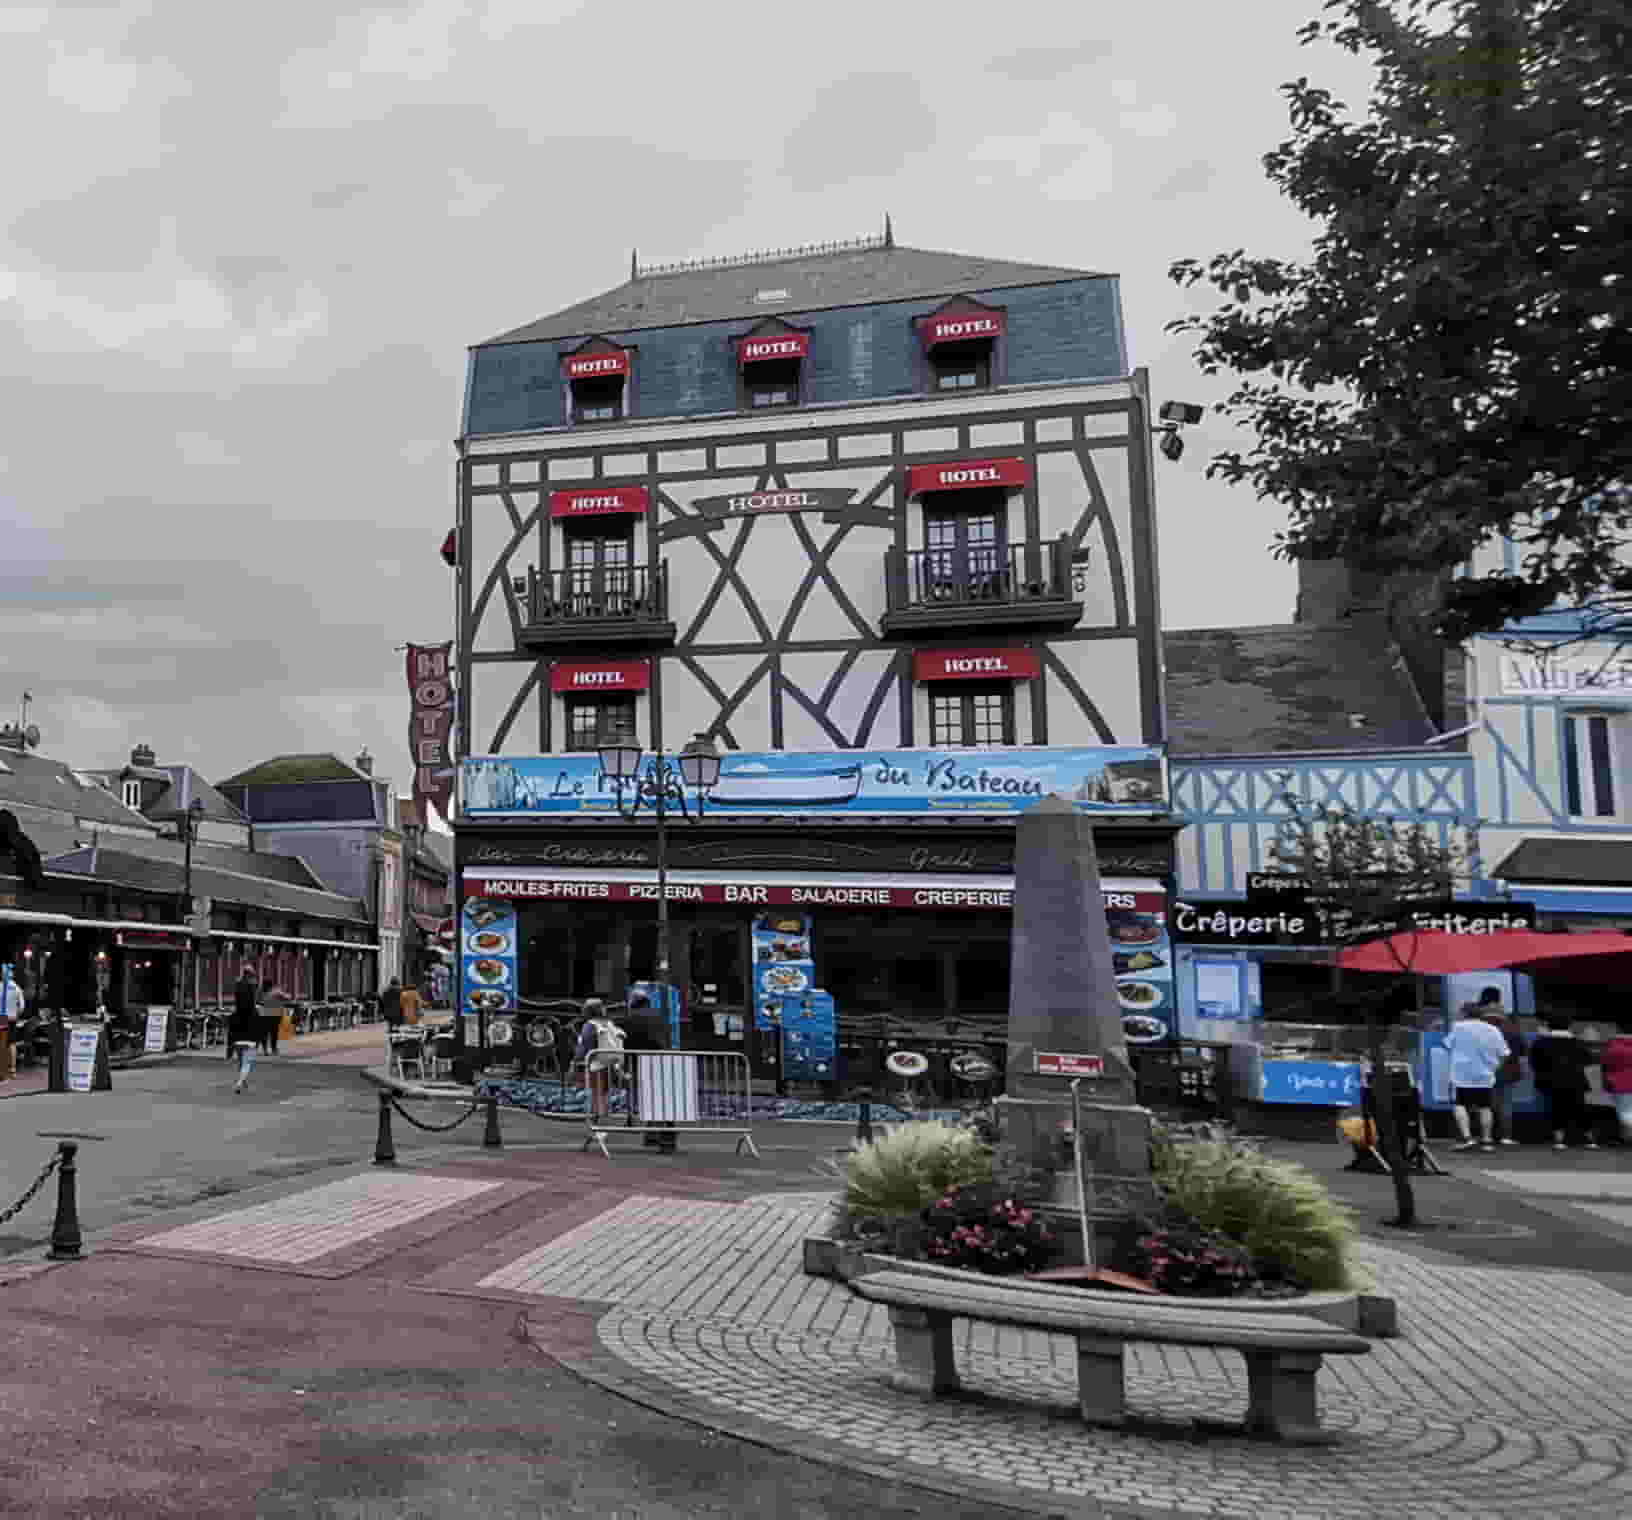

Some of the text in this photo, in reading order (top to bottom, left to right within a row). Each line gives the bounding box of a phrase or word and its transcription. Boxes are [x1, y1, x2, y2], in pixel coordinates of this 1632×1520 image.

[934, 318, 999, 336] HOTEL
[745, 341, 801, 356] HOTEL
[570, 358, 623, 374] HOTEL
[939, 466, 1001, 483] HOTEL
[570, 495, 624, 511] HOTEL
[727, 493, 819, 512] HOTEL
[943, 657, 1008, 673] HOTEL
[572, 670, 626, 686] HOTEL
[874, 758, 1043, 796] du Bateau
[484, 880, 608, 897] MOULES-FRITES
[725, 887, 767, 902] BAR
[791, 889, 890, 904] SALADERIE
[914, 891, 1011, 907] CREPERIE
[1175, 903, 1305, 936] Crêperie
